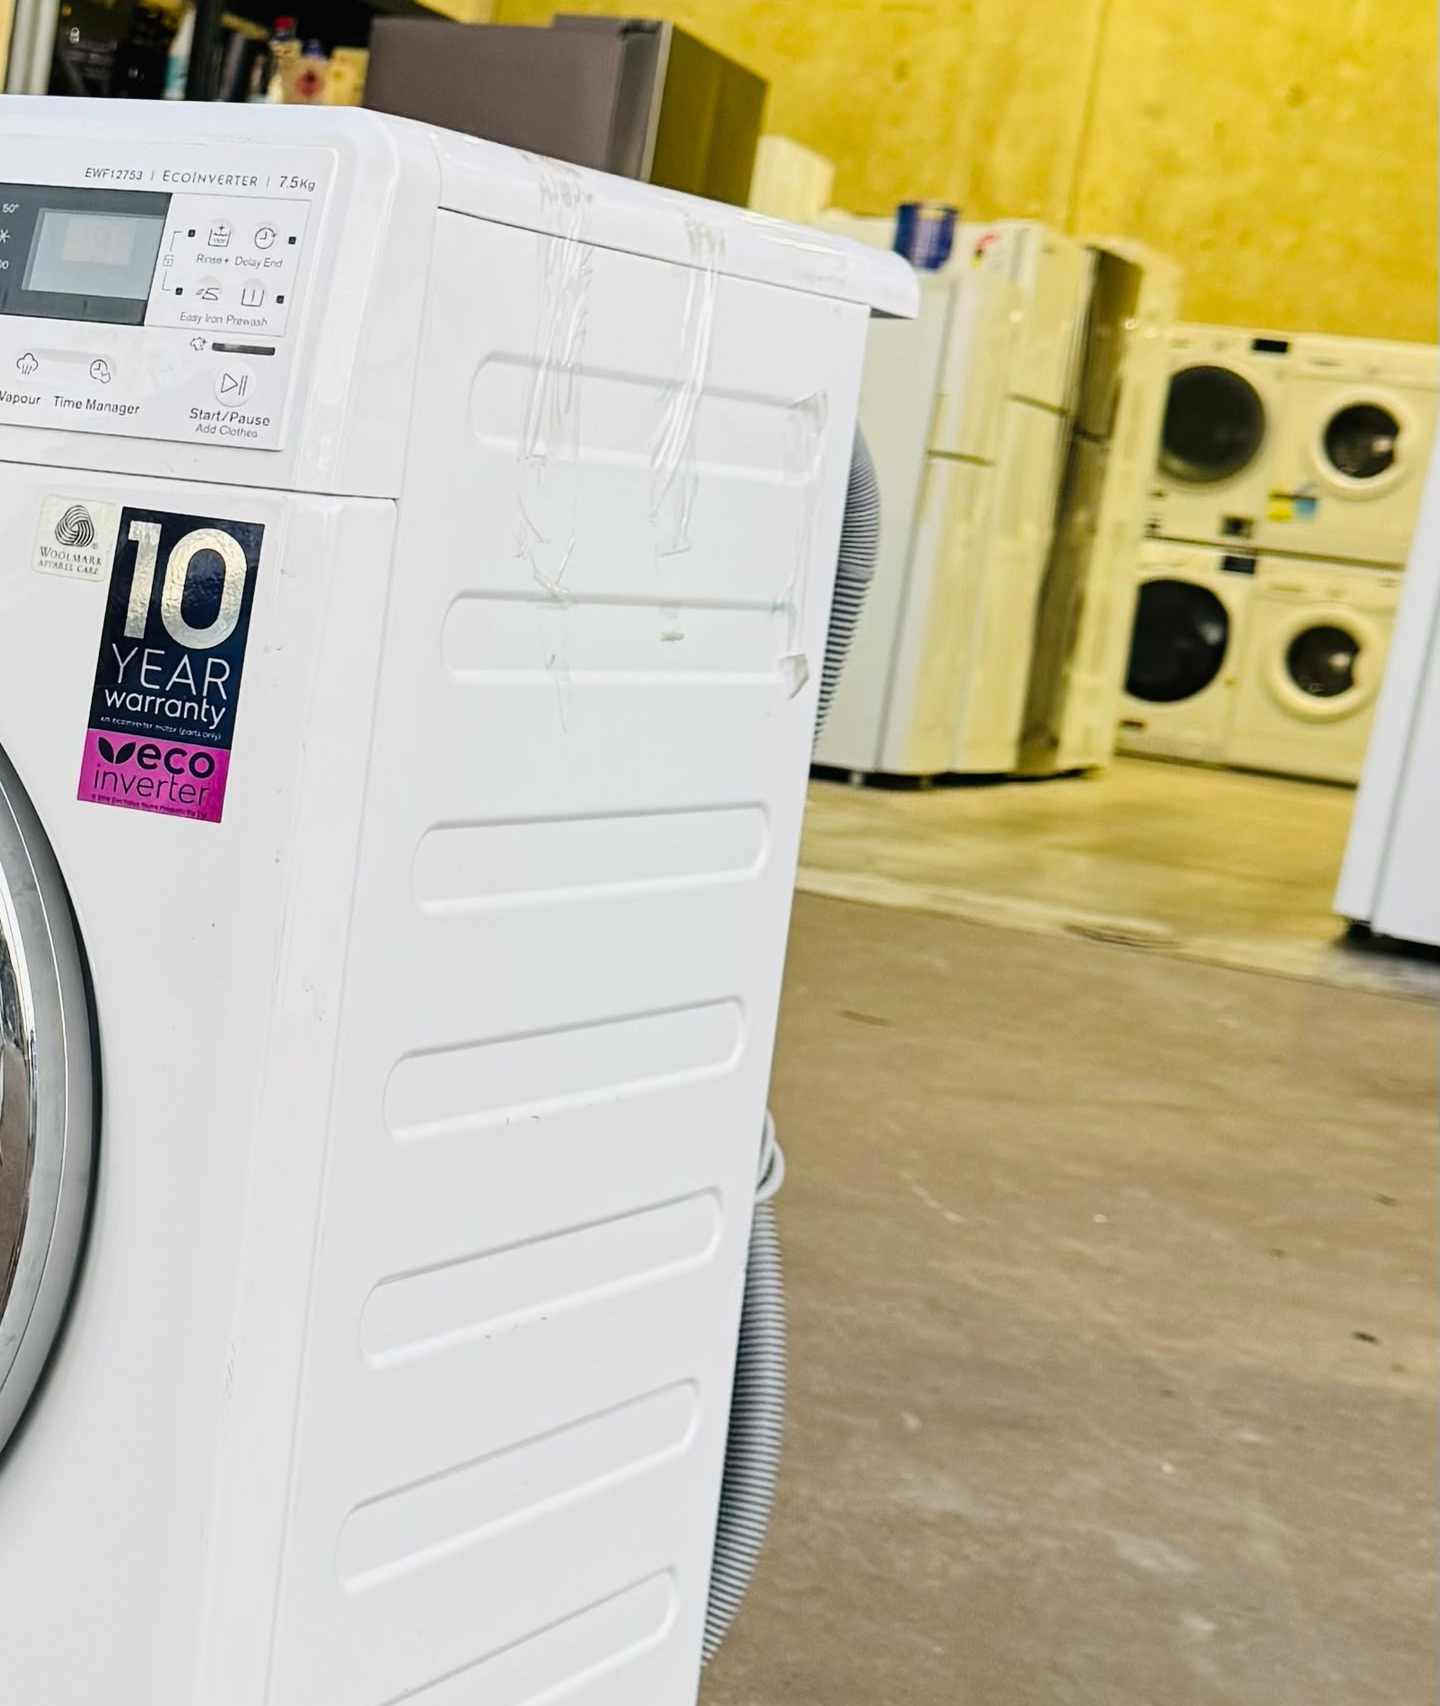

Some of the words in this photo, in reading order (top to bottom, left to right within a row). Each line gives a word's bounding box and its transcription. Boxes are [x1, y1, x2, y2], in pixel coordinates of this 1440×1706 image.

[85, 167, 143, 181] EWF12753
[235, 255, 261, 269] Delay
[263, 257, 283, 268] End
[180, 311, 202, 325] Easy
[205, 313, 223, 324] Iron
[226, 314, 268, 327] Prewash
[0, 390, 41, 406] Vapour
[54, 395, 83, 410] Time
[85, 398, 140, 416] Manager
[189, 407, 271, 427] Start/Pause
[195, 422, 217, 435] Add
[219, 424, 258, 439] Clothes
[40, 546, 102, 566] WOOLMARK
[39, 559, 73, 572] APPAREL
[76, 564, 100, 575] CARE
[123, 520, 248, 650] 10
[111, 642, 231, 701] YEAR
[105, 688, 227, 730] warranty
[136, 742, 216, 779] eco
[93, 763, 211, 807] inverter
